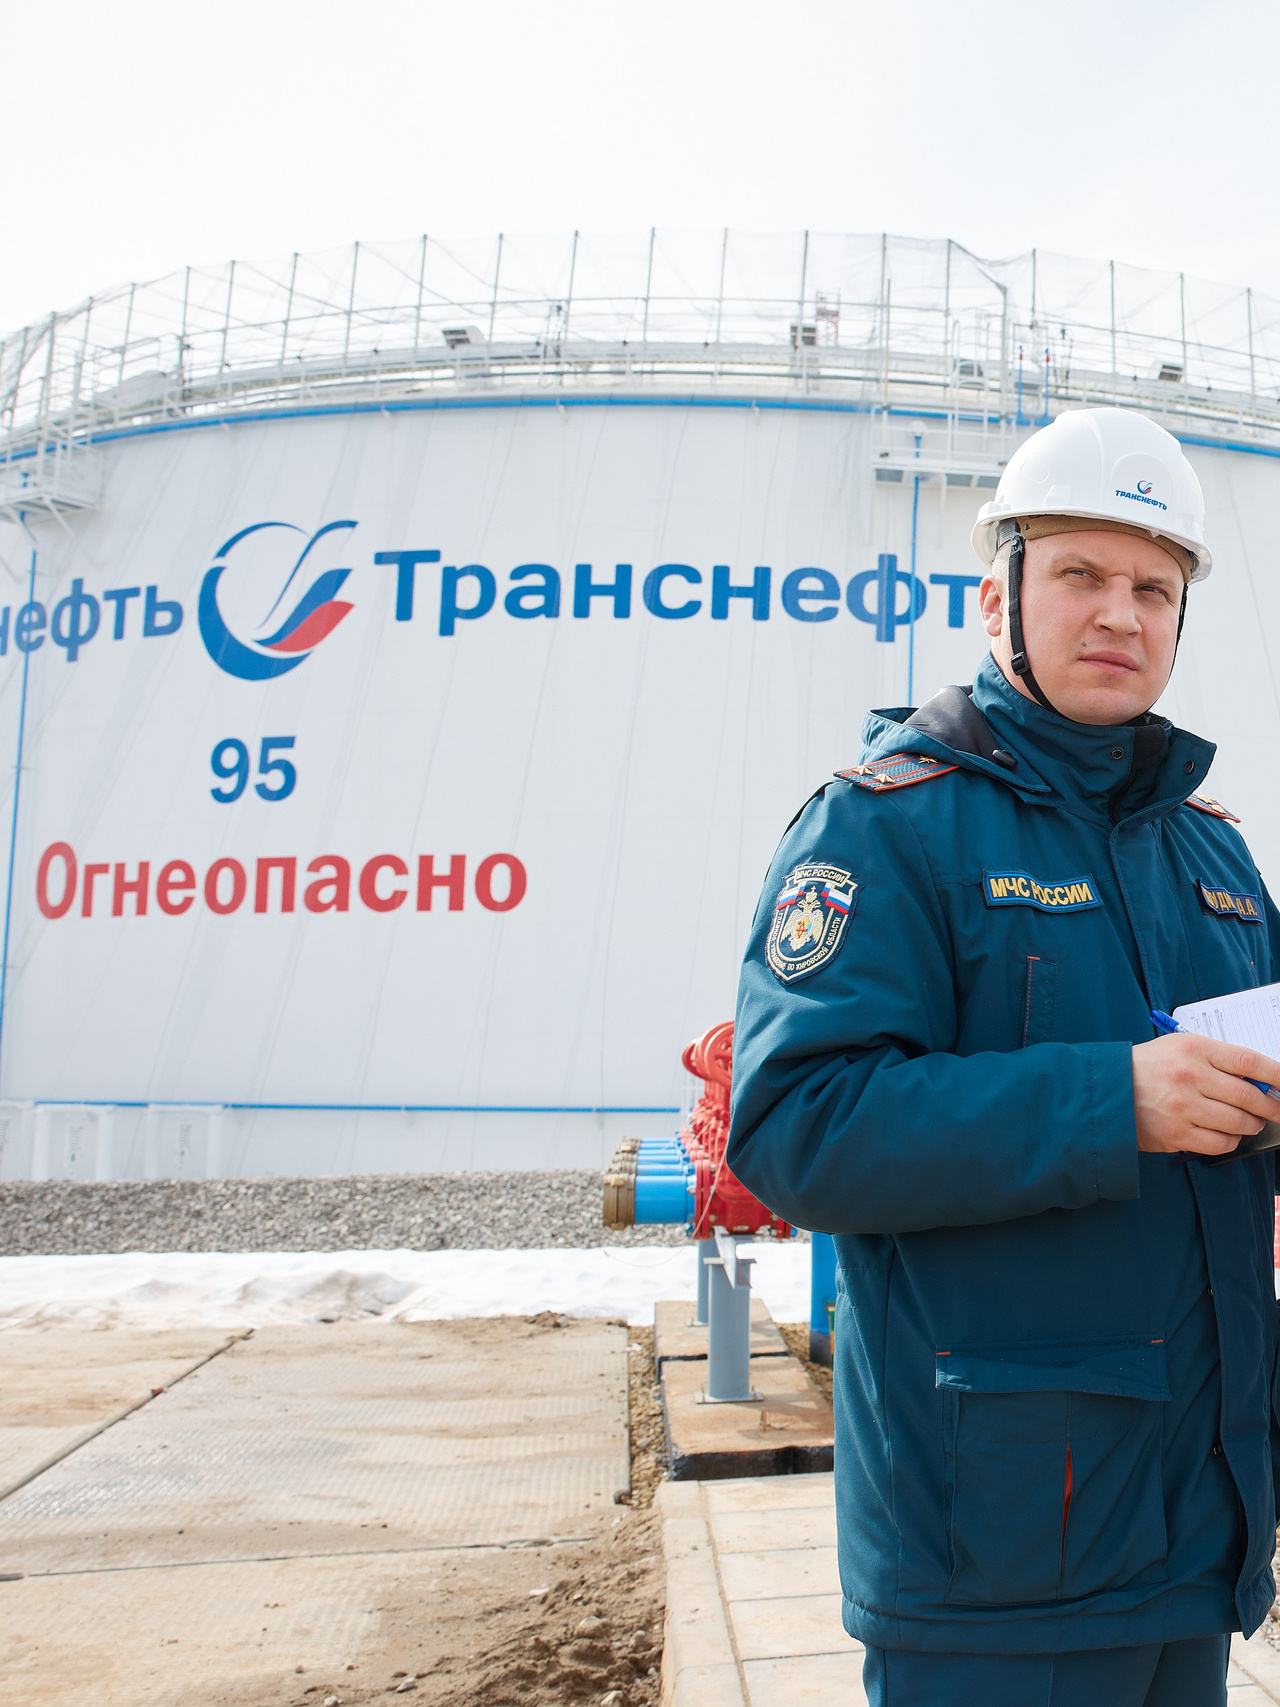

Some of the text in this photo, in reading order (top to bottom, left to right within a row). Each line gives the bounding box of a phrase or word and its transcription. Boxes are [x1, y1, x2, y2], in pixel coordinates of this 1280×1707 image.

[1115, 490, 1167, 511] ТРАНСНЕФТЬ
[374, 549, 982, 642] Транснефт
[210, 736, 297, 804] 95
[36, 841, 528, 920] Огнеопасно
[812, 869, 846, 882] РОССИИ
[990, 877, 1094, 906] МЧС РОССИИ
[825, 917, 842, 946] ОБЛАСТИ
